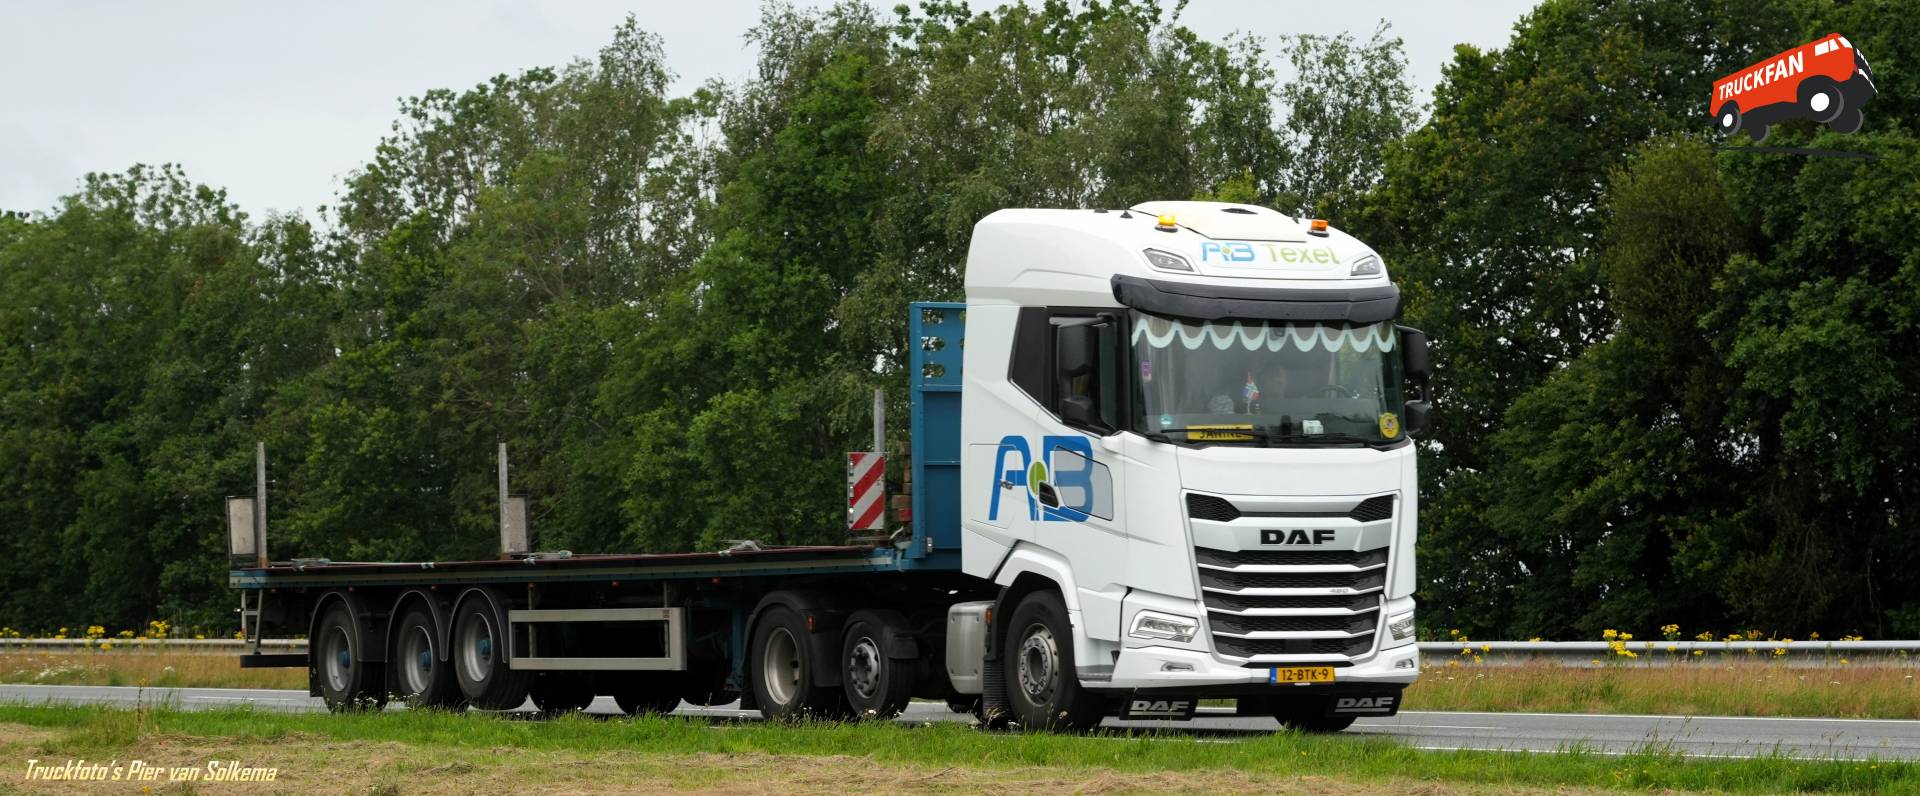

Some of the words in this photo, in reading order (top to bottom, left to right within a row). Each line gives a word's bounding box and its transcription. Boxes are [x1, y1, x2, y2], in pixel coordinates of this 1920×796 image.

[1260, 243, 1340, 264] Texel
[988, 435, 1094, 522] AB
[1260, 529, 1336, 545] DAF
[1281, 668, 1329, 681] 12-BTK-9
[1130, 700, 1190, 712] DAF
[1336, 697, 1394, 708] DAF
